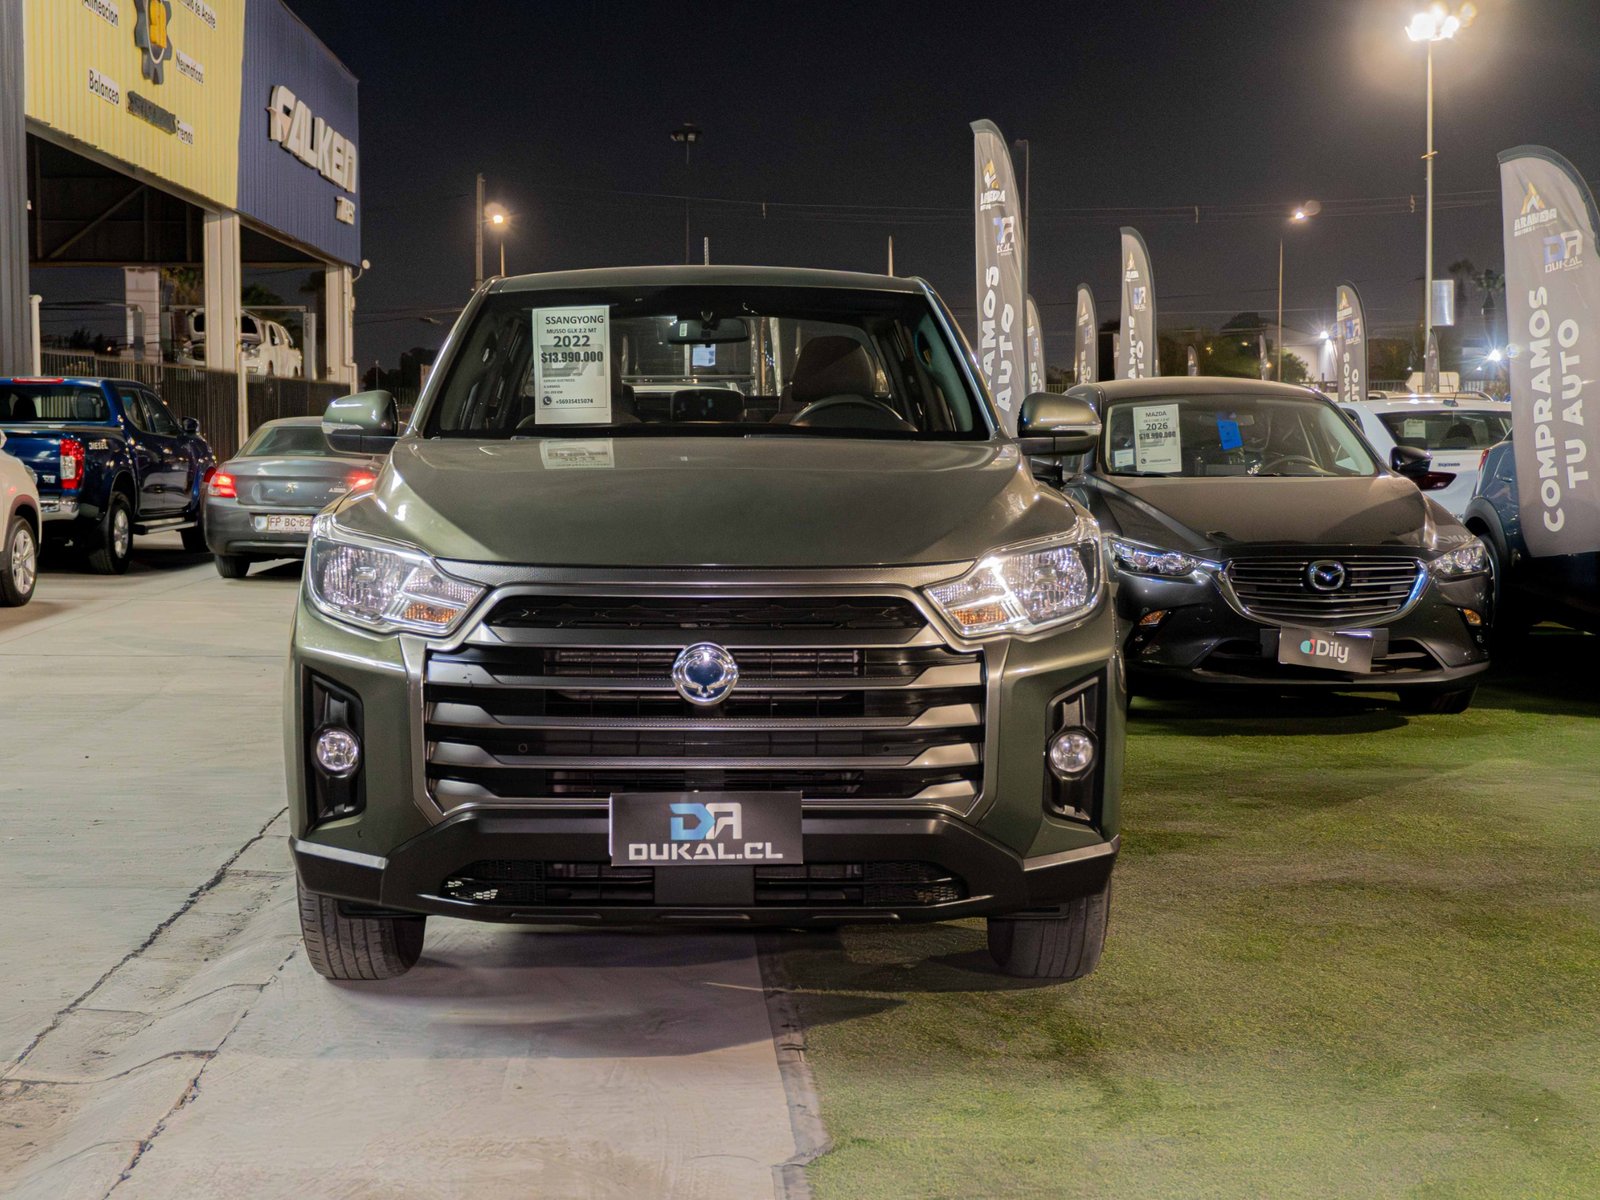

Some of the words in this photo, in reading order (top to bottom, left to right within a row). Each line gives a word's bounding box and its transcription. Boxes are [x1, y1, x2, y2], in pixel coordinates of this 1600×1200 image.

[88, 69, 119, 105] Balanceo
[177, 120, 193, 145] Frenos
[1545, 256, 1583, 273] DUKAL
[545, 315, 604, 325] SSANGYONG
[553, 335, 590, 347] 2022
[541, 351, 604, 364] $13.990.000
[996, 303, 1014, 412] AUTO
[1557, 318, 1585, 426] AUTO
[1529, 286, 1565, 532] COMPRAMOS
[1565, 439, 1589, 489] TU
[1316, 640, 1349, 664] Dily
[669, 802, 742, 840] DA
[628, 842, 784, 861] DUKAL.CL
